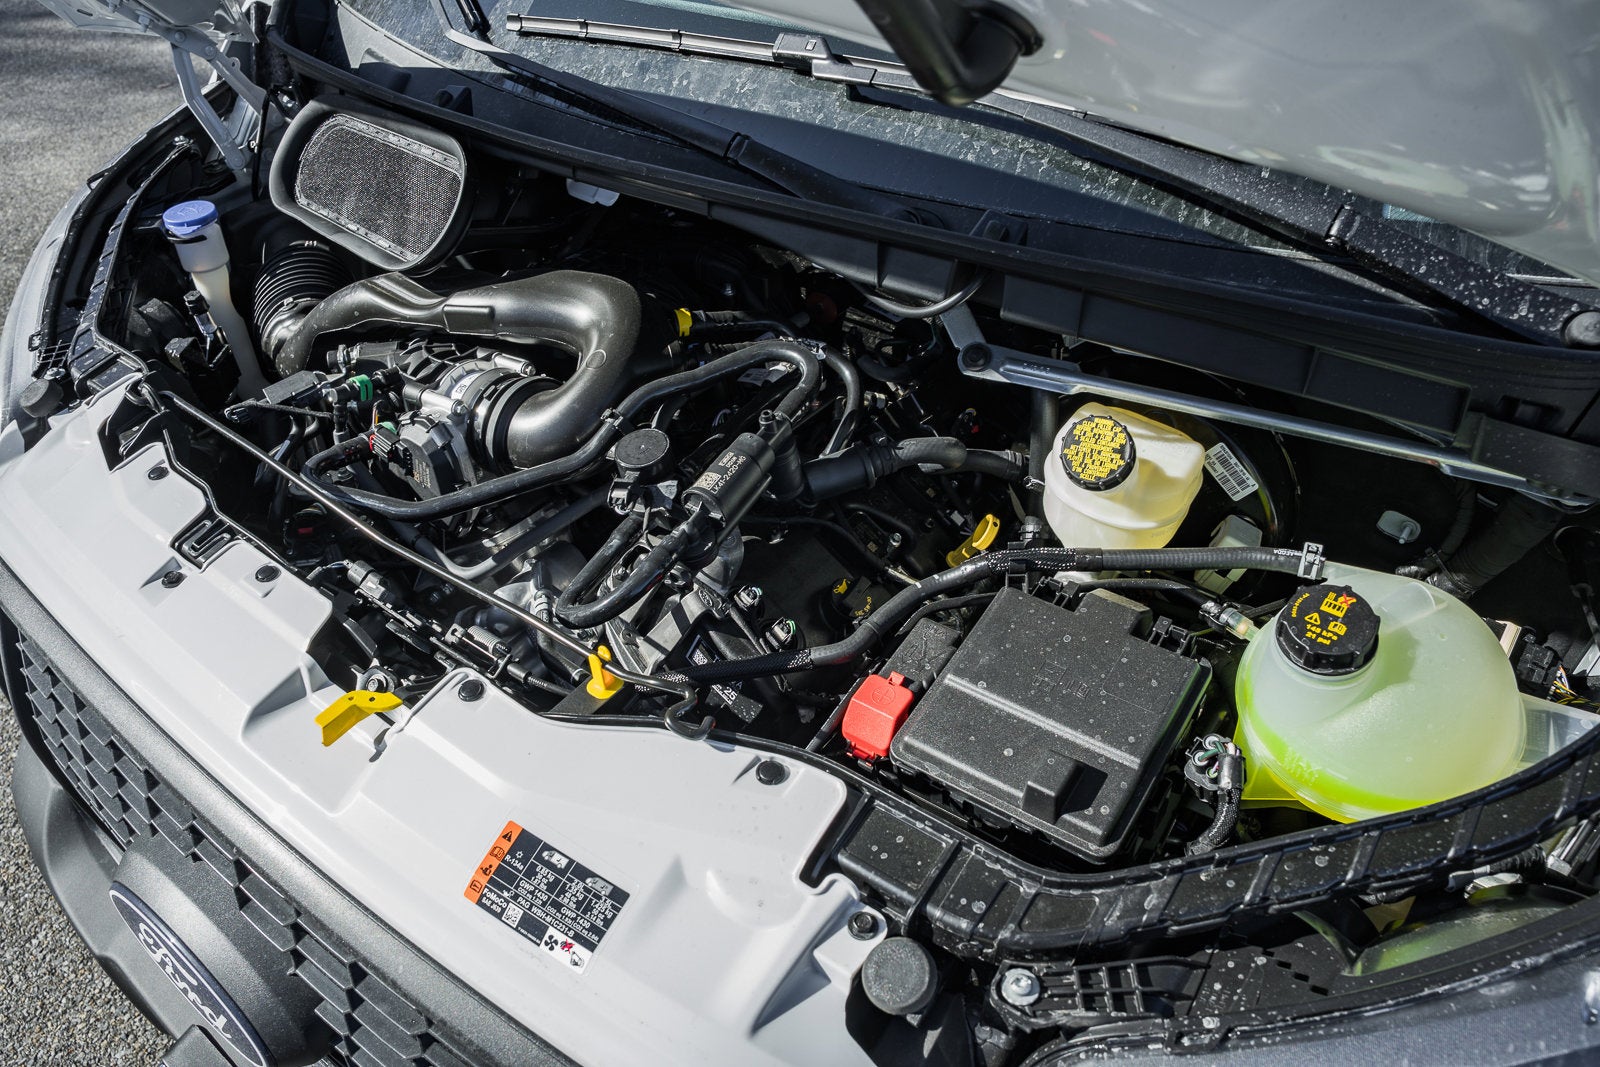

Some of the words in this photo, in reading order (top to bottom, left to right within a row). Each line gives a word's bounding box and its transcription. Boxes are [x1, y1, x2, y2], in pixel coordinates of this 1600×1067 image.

[505, 855, 523, 870] R-134a
[547, 872, 555, 882] kg
[483, 888, 507, 908] FoMoCo
[520, 880, 534, 891] GWP
[534, 890, 548, 901] 1430
[566, 882, 578, 894] 1.35
[576, 889, 585, 900] kg
[517, 897, 530, 908] PAG
[591, 899, 606, 912] 1.425
[605, 909, 613, 918] kg
[561, 907, 576, 918] GWP
[576, 917, 590, 928] 1430
[138, 922, 232, 1040] Ford
